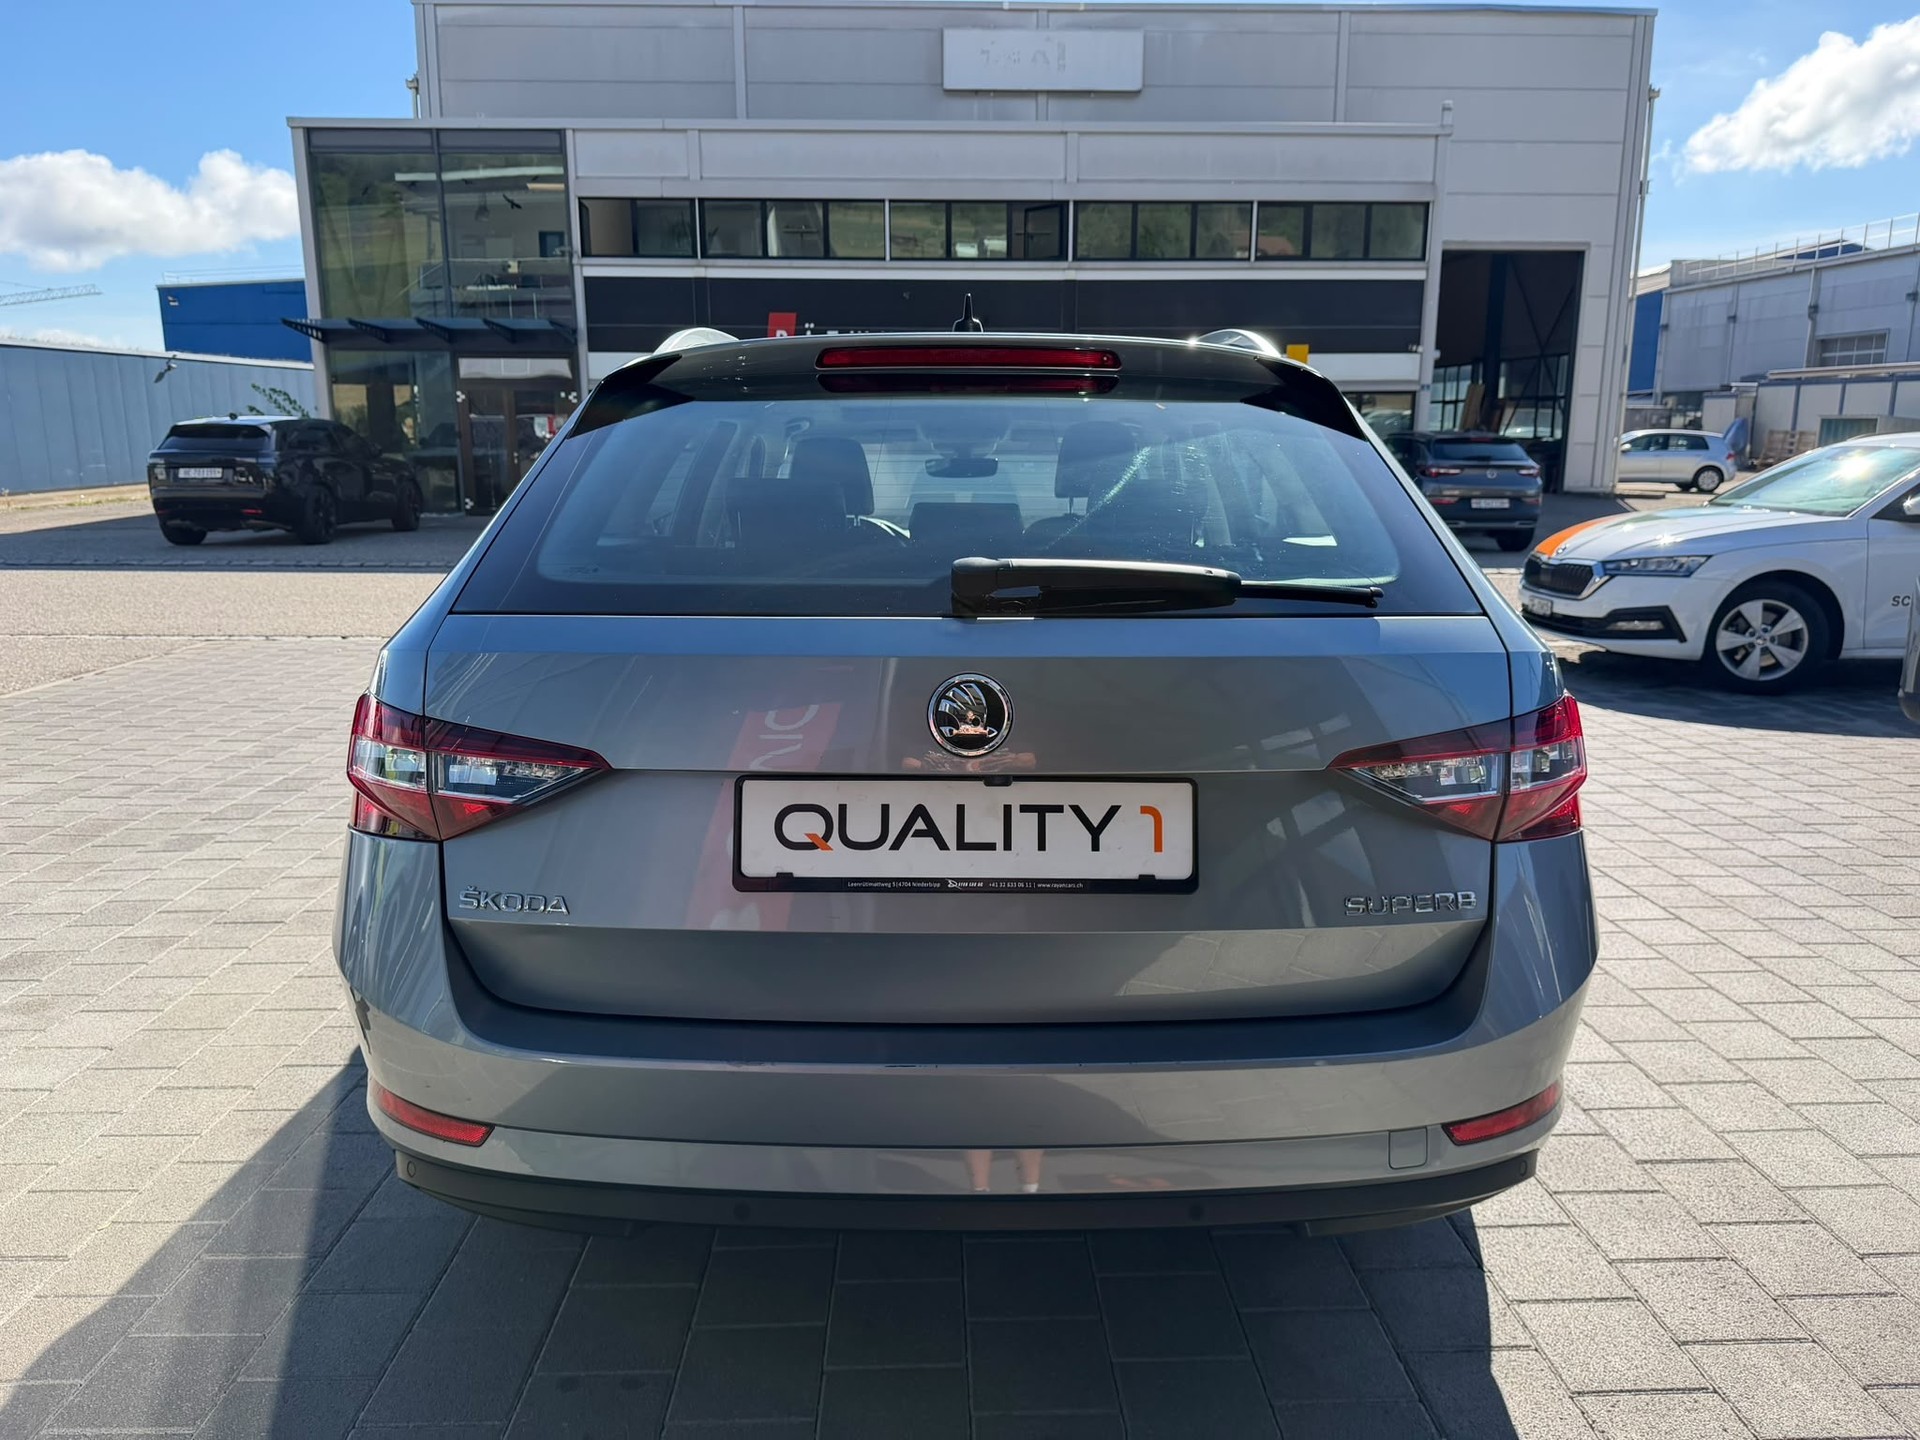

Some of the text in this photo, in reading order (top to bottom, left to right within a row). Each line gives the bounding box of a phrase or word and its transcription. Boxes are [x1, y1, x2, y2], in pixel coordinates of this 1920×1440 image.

[774, 803, 1163, 853] QUALITY 1
[458, 885, 570, 916] ŠKODA
[1345, 891, 1477, 916] SUPERB
